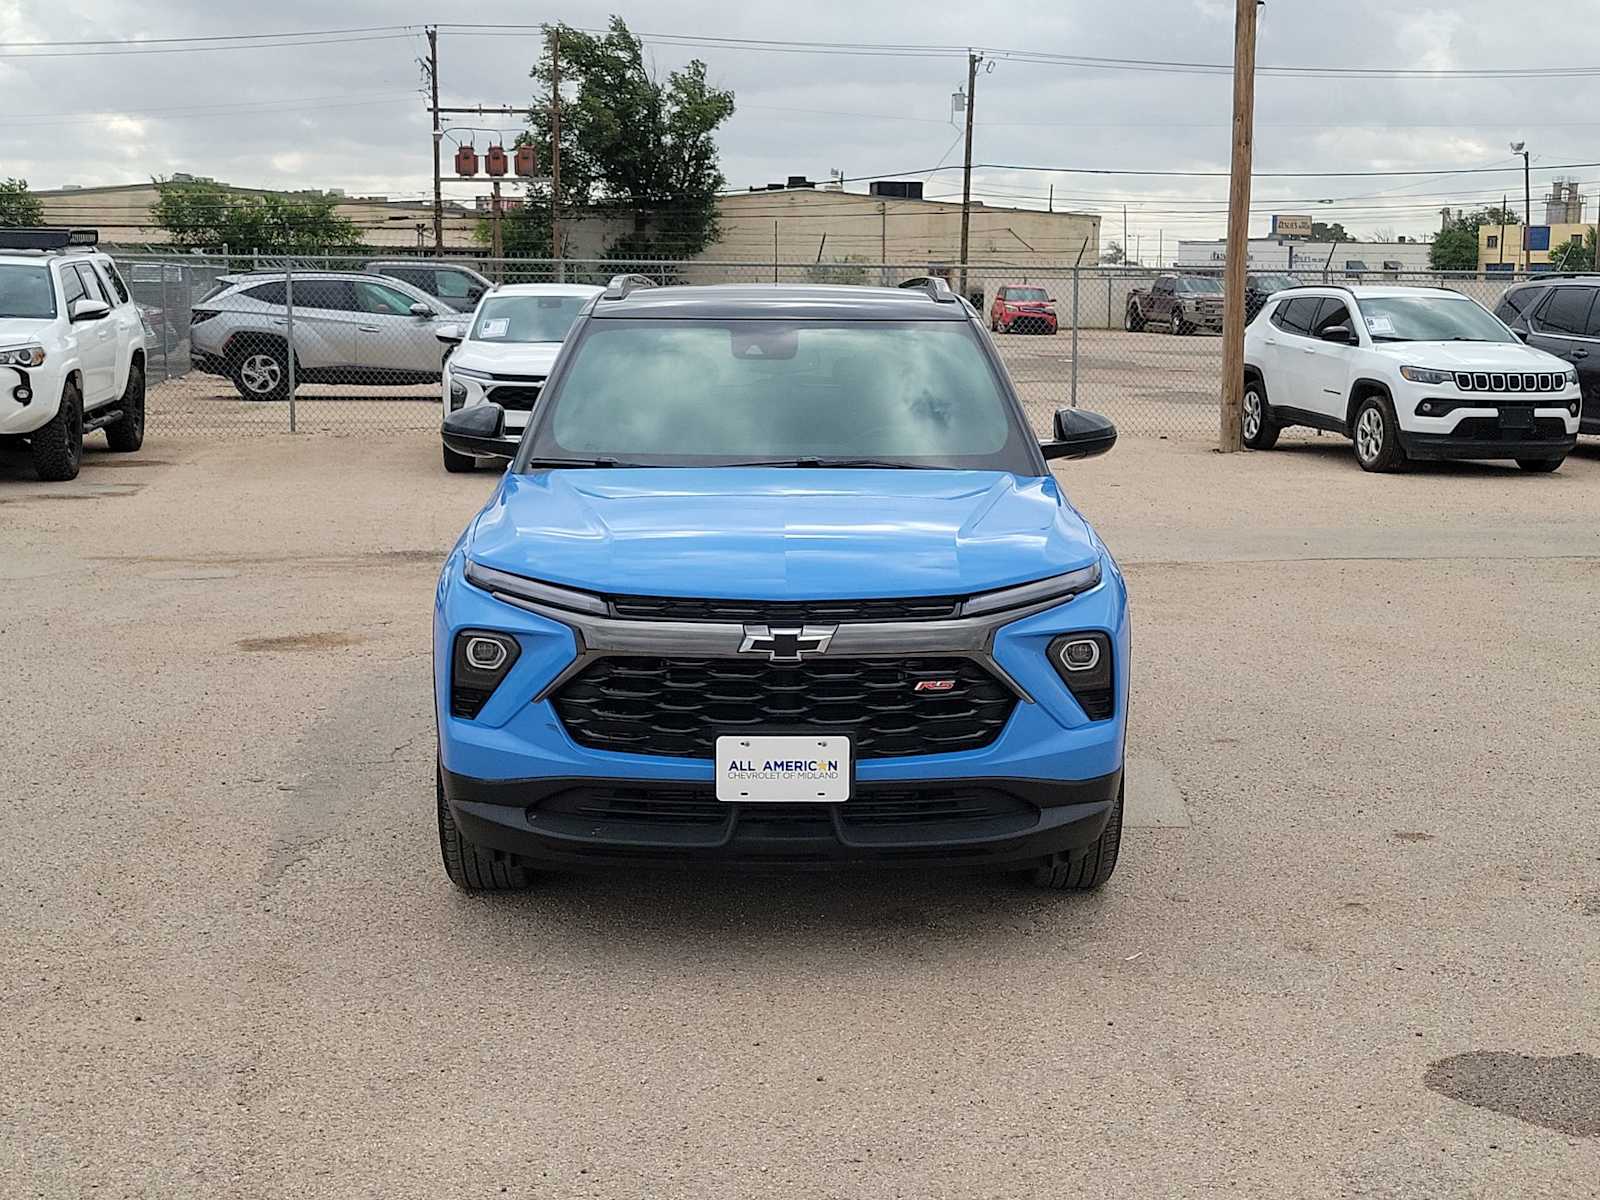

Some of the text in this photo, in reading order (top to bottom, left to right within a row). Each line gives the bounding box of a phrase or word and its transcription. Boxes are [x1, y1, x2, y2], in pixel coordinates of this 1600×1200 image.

[914, 679, 956, 691] RS
[728, 760, 756, 771] ALL
[728, 771, 838, 780] CHEVROLET OF MIDLAND
